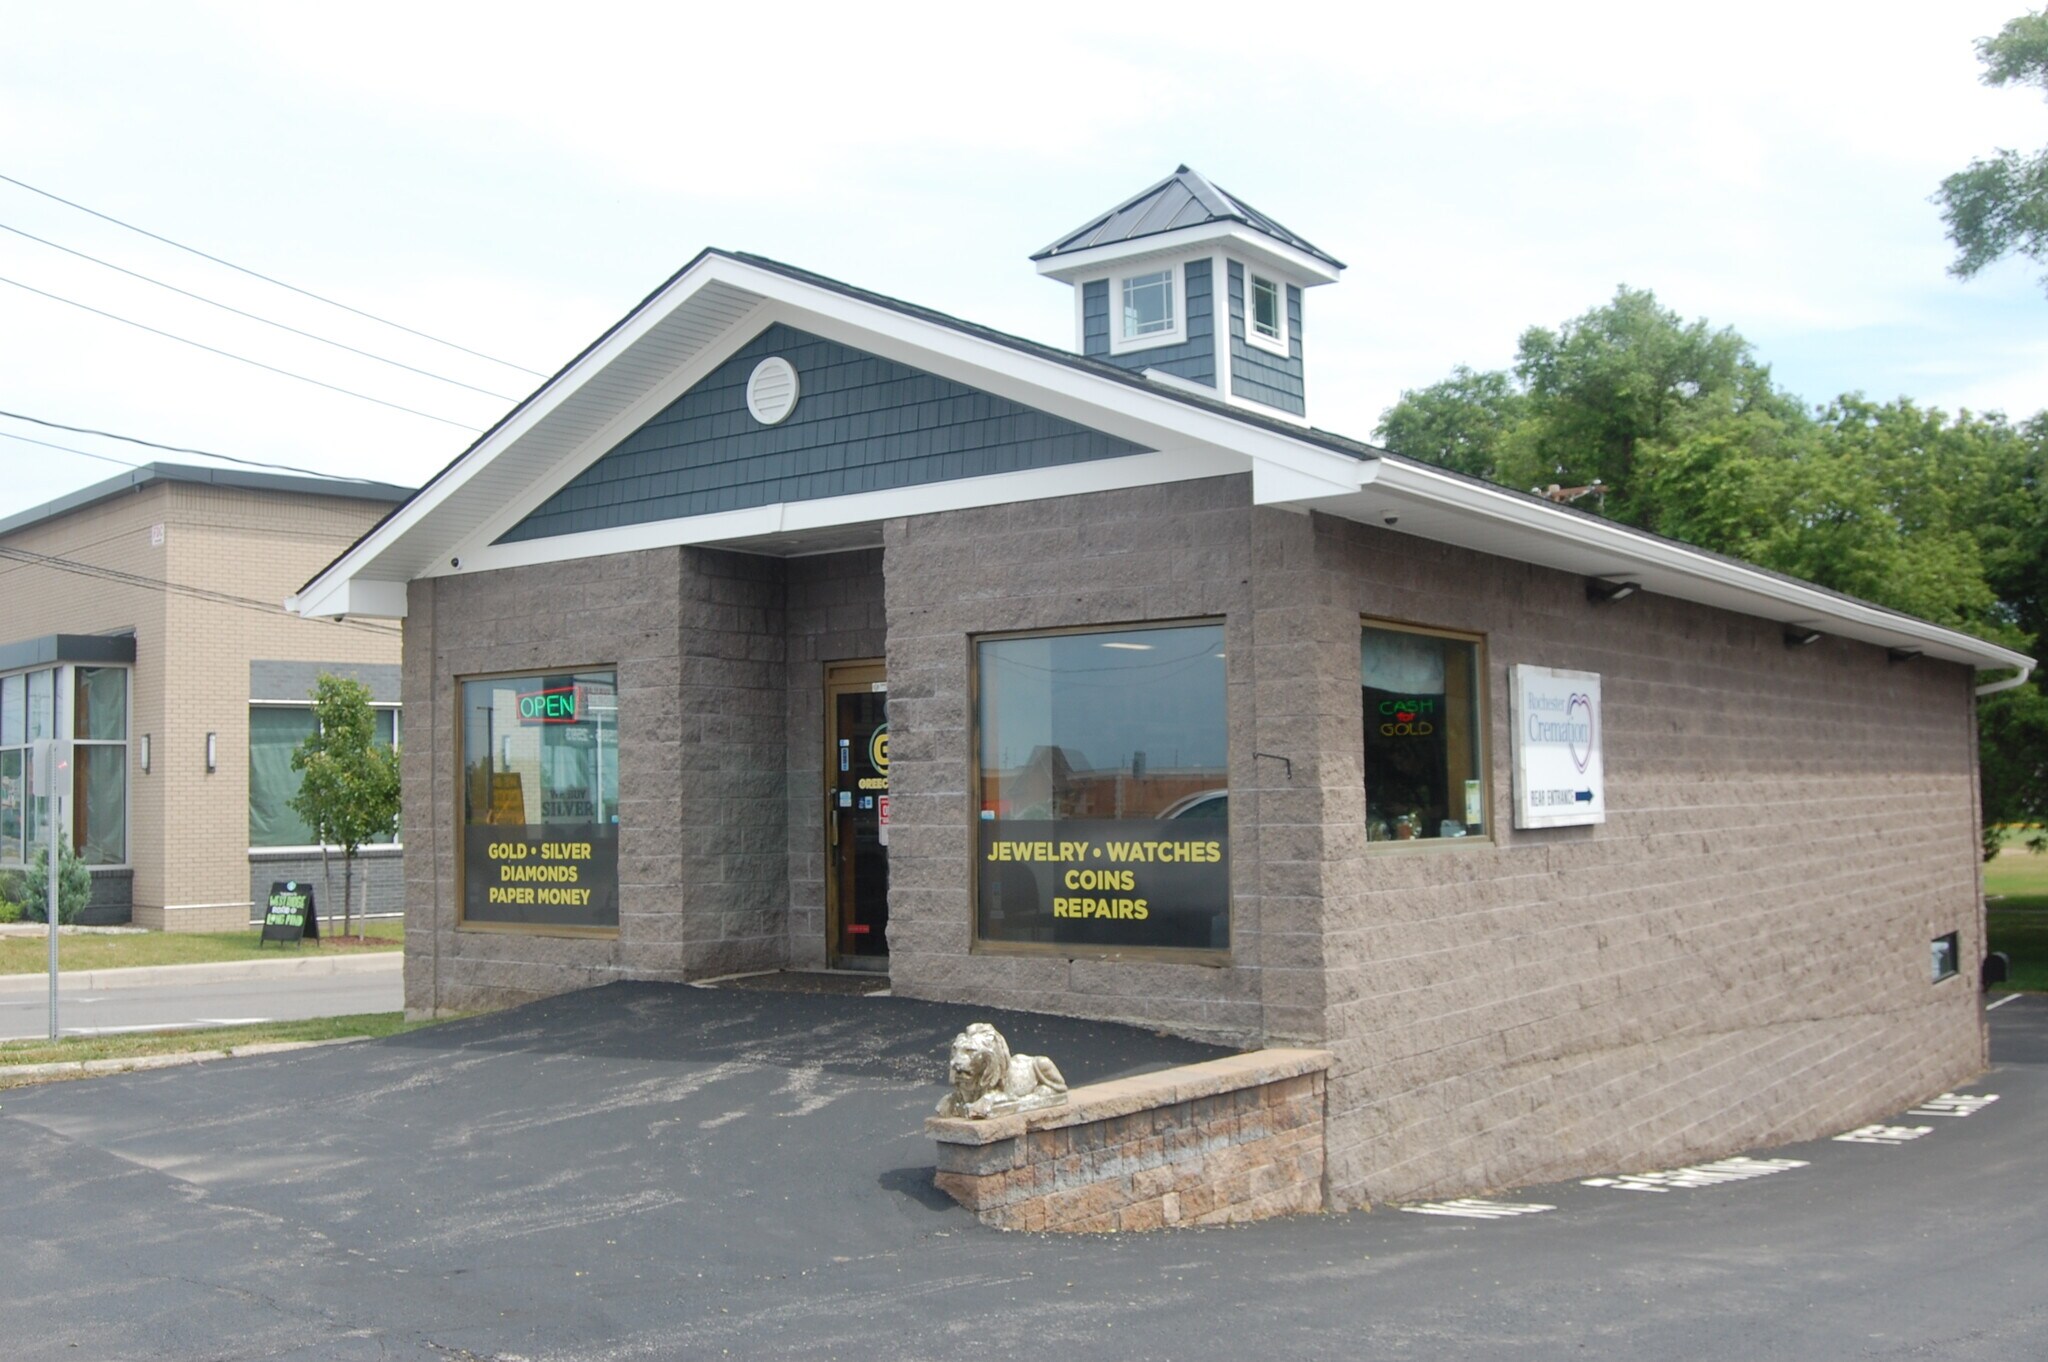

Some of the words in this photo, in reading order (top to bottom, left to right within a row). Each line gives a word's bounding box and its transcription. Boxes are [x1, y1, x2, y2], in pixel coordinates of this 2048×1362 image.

[519, 695, 574, 718] OPEN
[1379, 699, 1434, 715] CASH
[1528, 692, 1565, 711] Rochester
[1380, 722, 1433, 736] GOLD
[1529, 713, 1588, 743] Cremation
[1547, 790, 1574, 806] ENTRANCE
[542, 801, 594, 817] SILVER
[488, 843, 527, 859] GOLD
[541, 843, 591, 859] SILVER
[987, 841, 1089, 861] JEWELRY
[1106, 841, 1222, 862] WATCHES
[500, 865, 578, 882] DIAMONDS
[1064, 869, 1135, 891] COINS
[489, 887, 534, 904] PAPER
[537, 888, 591, 905] MONEY
[1053, 897, 1149, 920] REPAIRS
